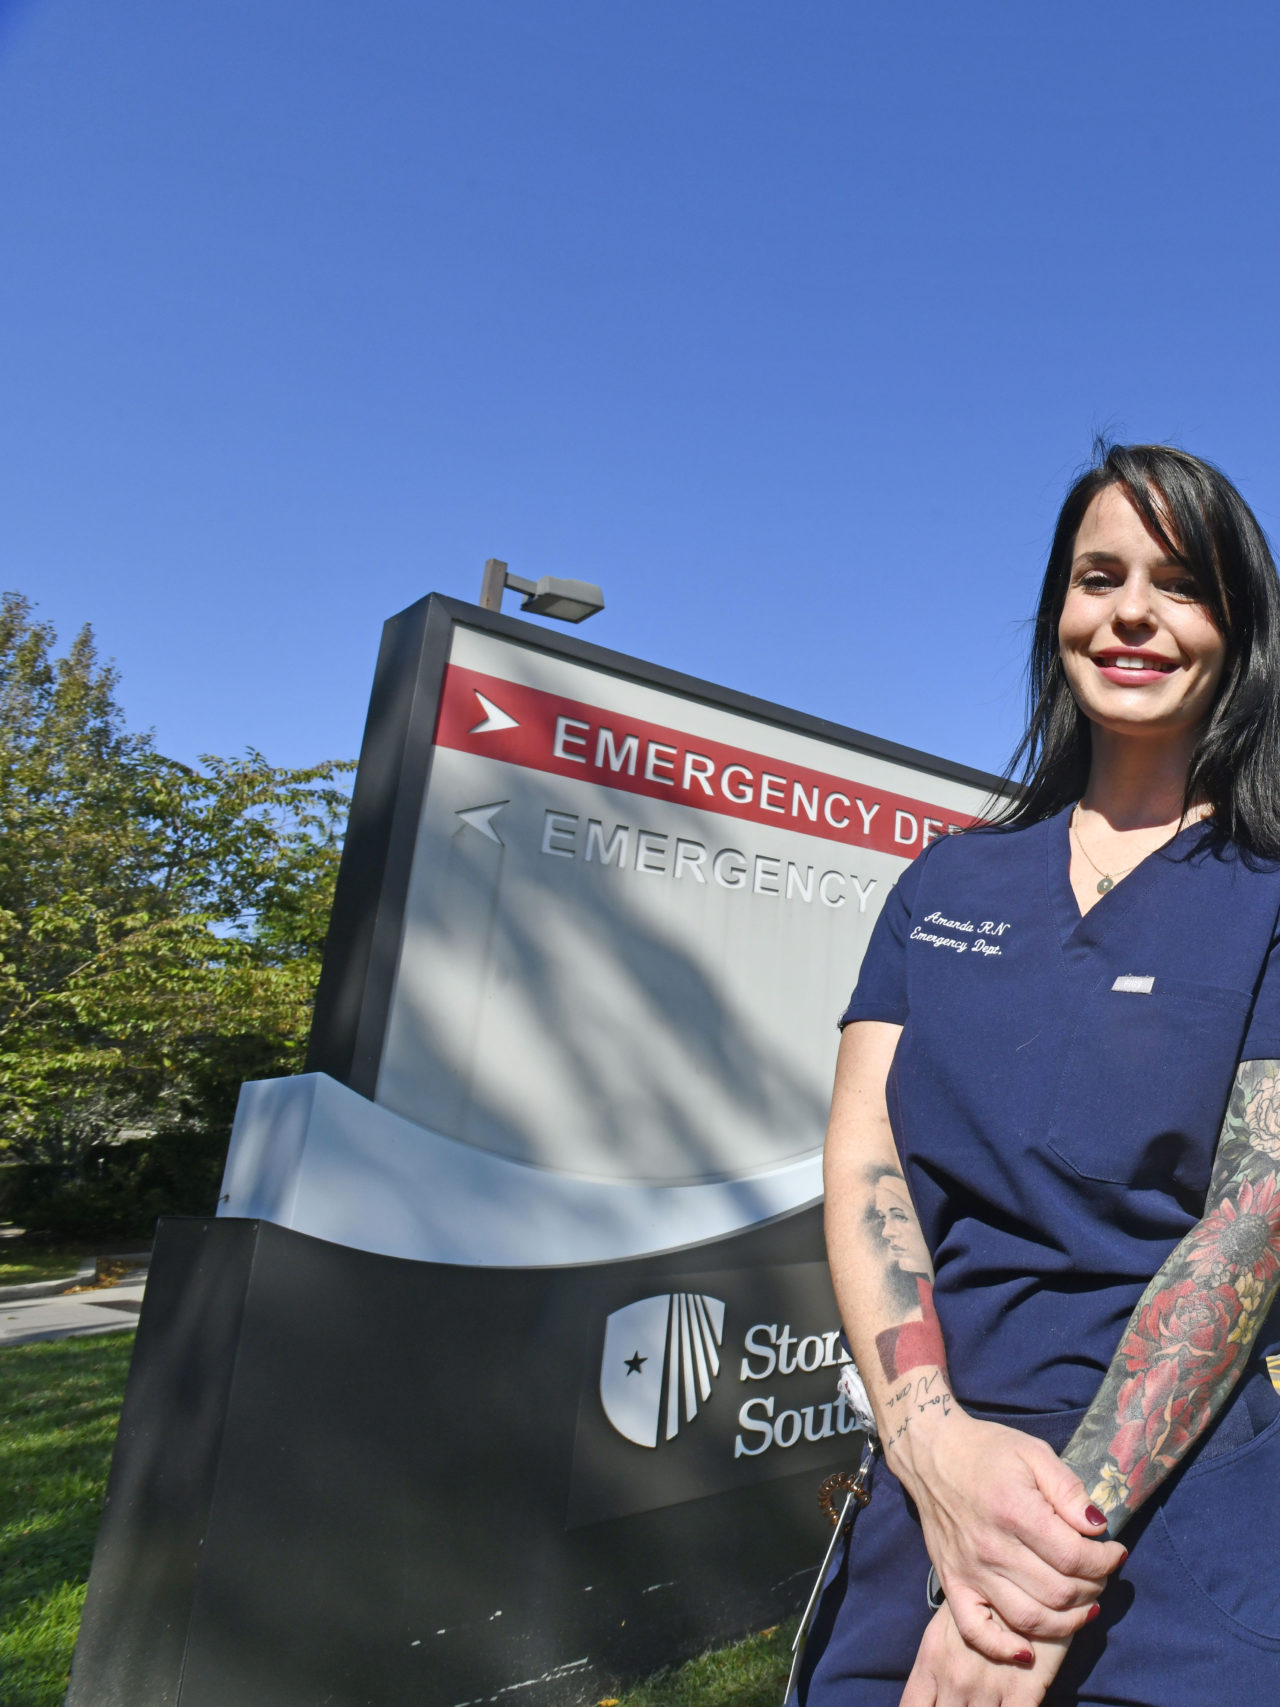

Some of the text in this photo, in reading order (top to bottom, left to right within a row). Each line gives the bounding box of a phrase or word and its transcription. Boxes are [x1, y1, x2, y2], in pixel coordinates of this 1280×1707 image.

[552, 714, 881, 836] EMERGENCY
[540, 807, 878, 913] EMERGENCY
[910, 926, 1002, 957] Emergency Dept.
[924, 911, 1011, 936] Amanda RN
[739, 1323, 853, 1381] Ston
[733, 1395, 863, 1458] Sout
